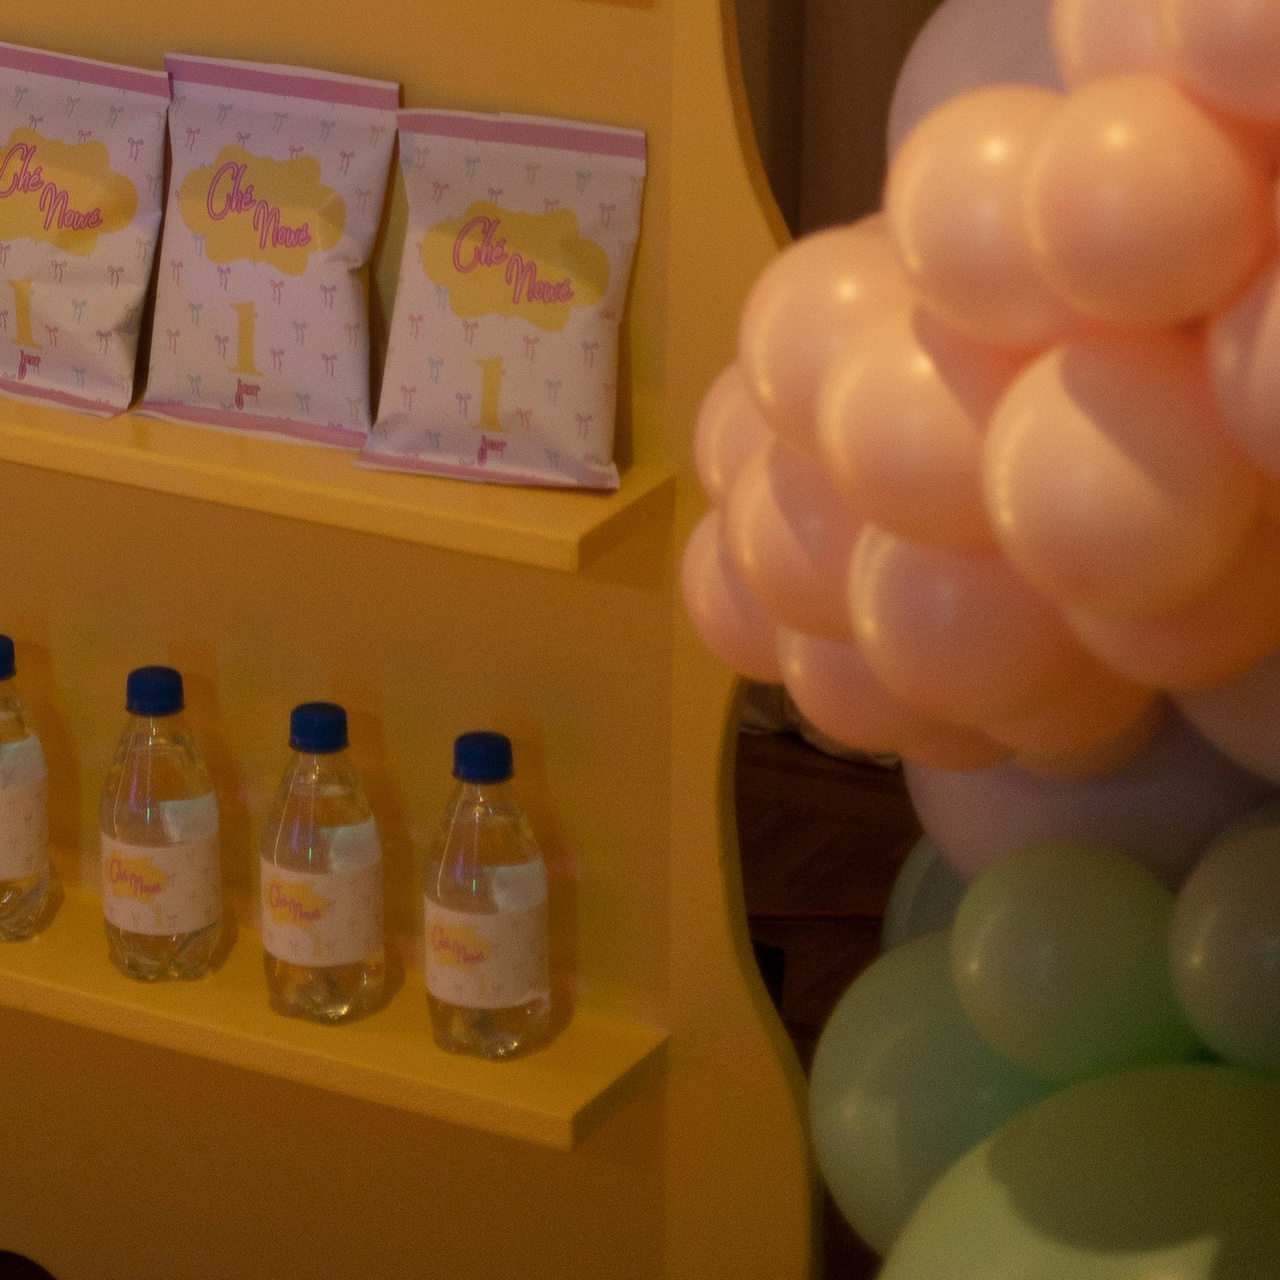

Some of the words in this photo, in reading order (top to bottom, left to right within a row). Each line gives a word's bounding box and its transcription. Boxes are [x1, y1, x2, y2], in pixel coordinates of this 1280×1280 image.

[40, 189, 103, 230] Nowé
[207, 162, 255, 220] Ché
[253, 201, 311, 249] Nowé
[7, 278, 39, 347] 1
[228, 302, 264, 376] 1
[473, 357, 506, 432] 1
